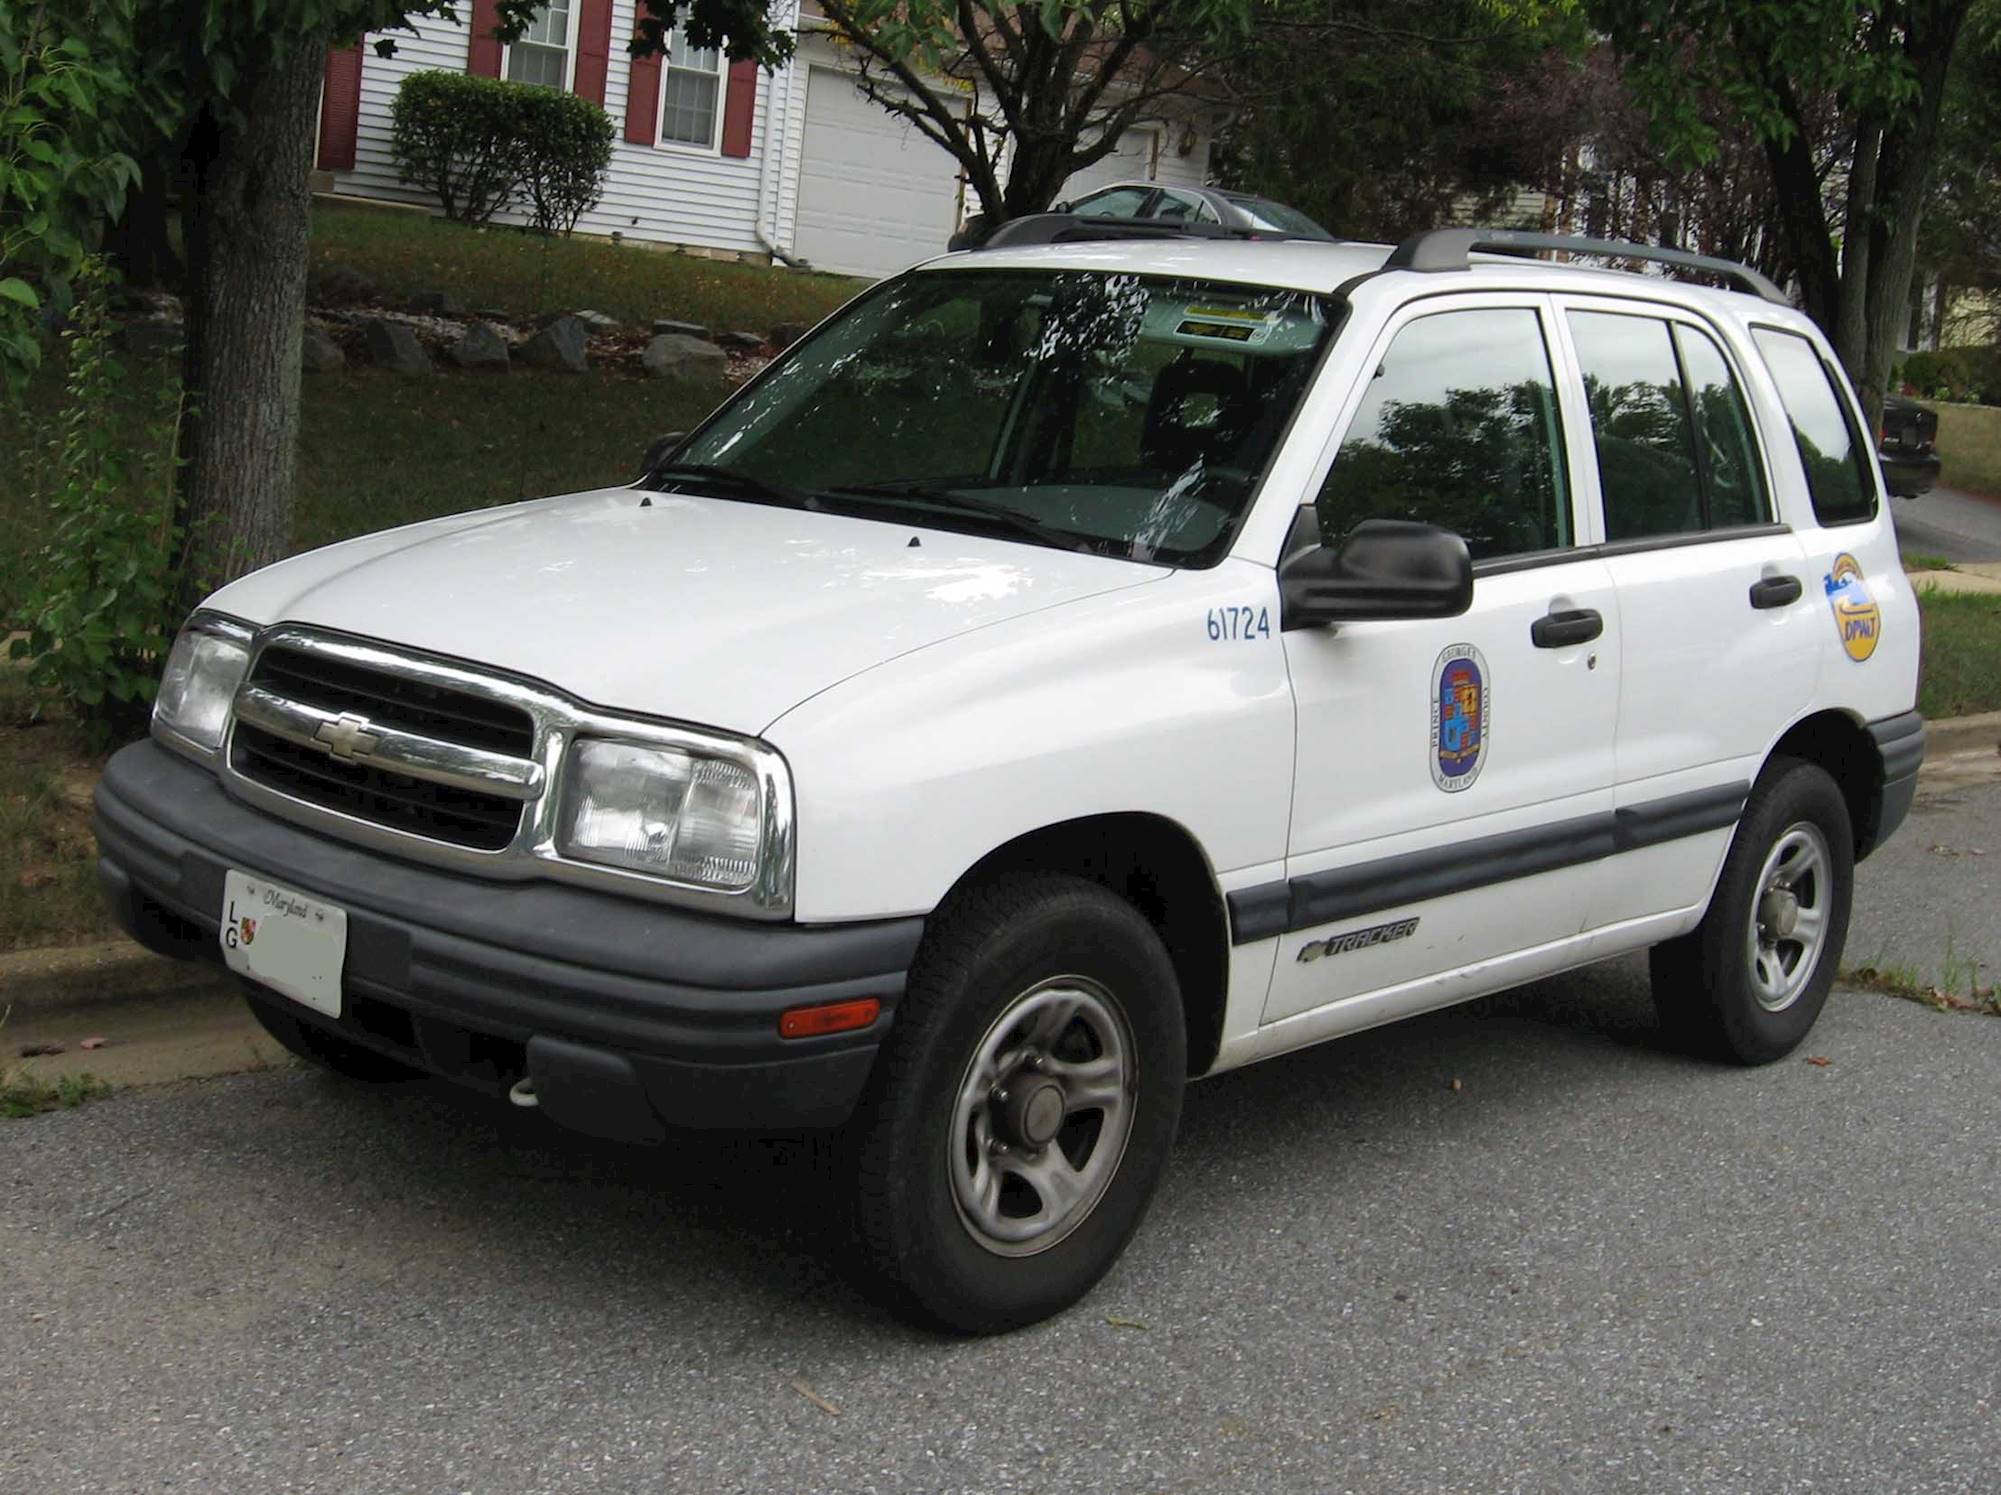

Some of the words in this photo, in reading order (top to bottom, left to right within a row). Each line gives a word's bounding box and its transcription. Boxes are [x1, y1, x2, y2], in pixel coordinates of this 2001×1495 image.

[1207, 606, 1270, 640] 61724
[263, 889, 309, 918] Maryland
[1326, 918, 1420, 955] TRACKER
